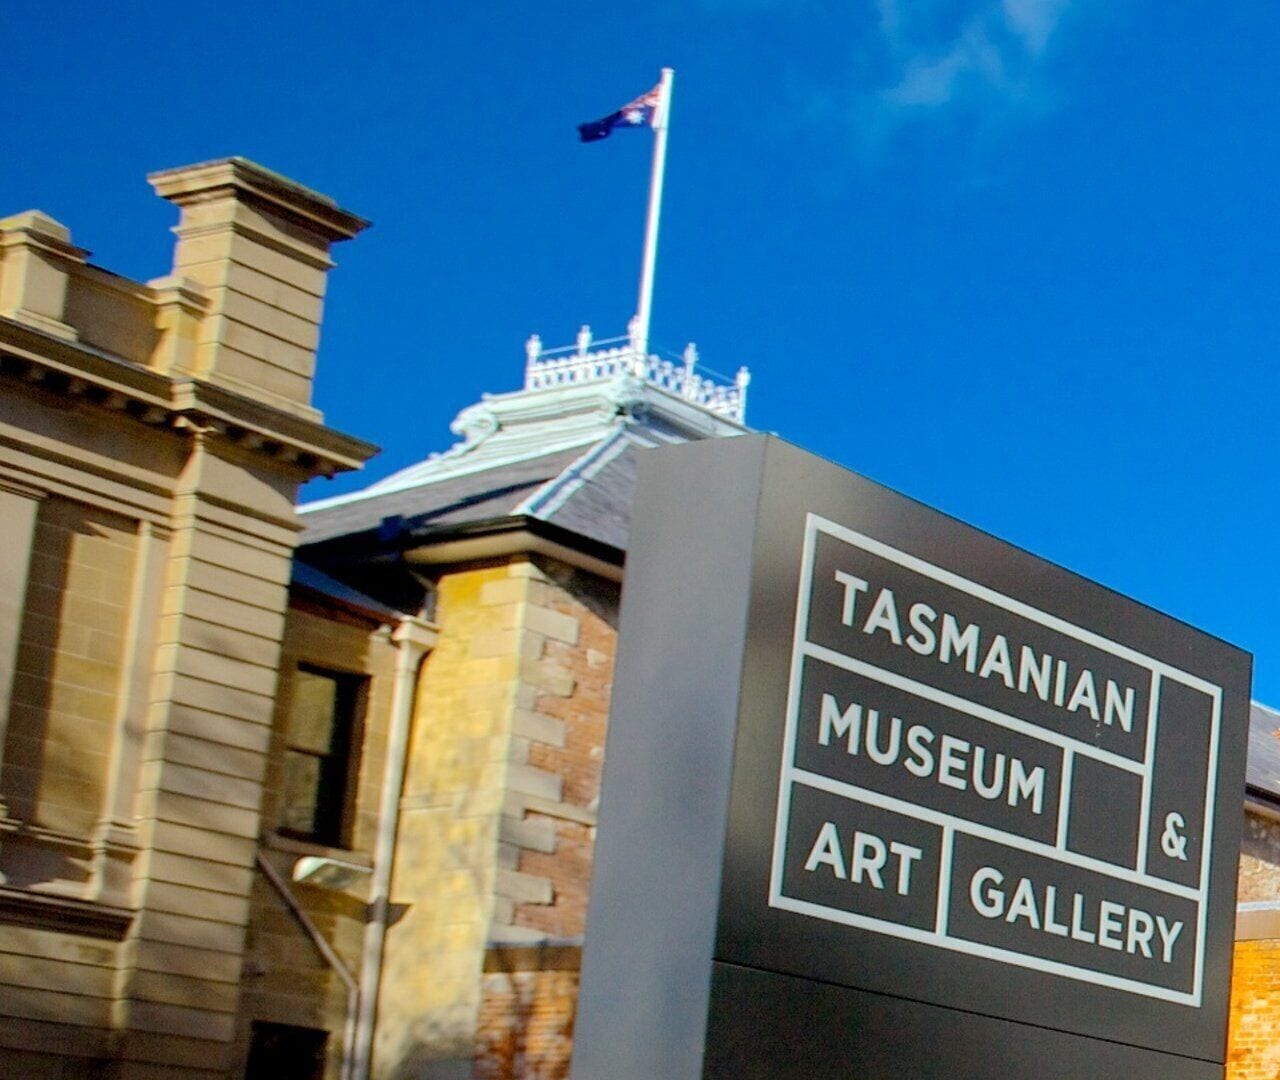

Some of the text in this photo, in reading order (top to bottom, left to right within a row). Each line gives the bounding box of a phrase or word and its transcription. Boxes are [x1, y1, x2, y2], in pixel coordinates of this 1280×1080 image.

[835, 570, 1135, 733] TASMANIAN
[818, 693, 1046, 814] MUSEUM
[804, 822, 923, 896] ART
[1161, 812, 1188, 861] &
[970, 867, 1185, 964] GALLERY
